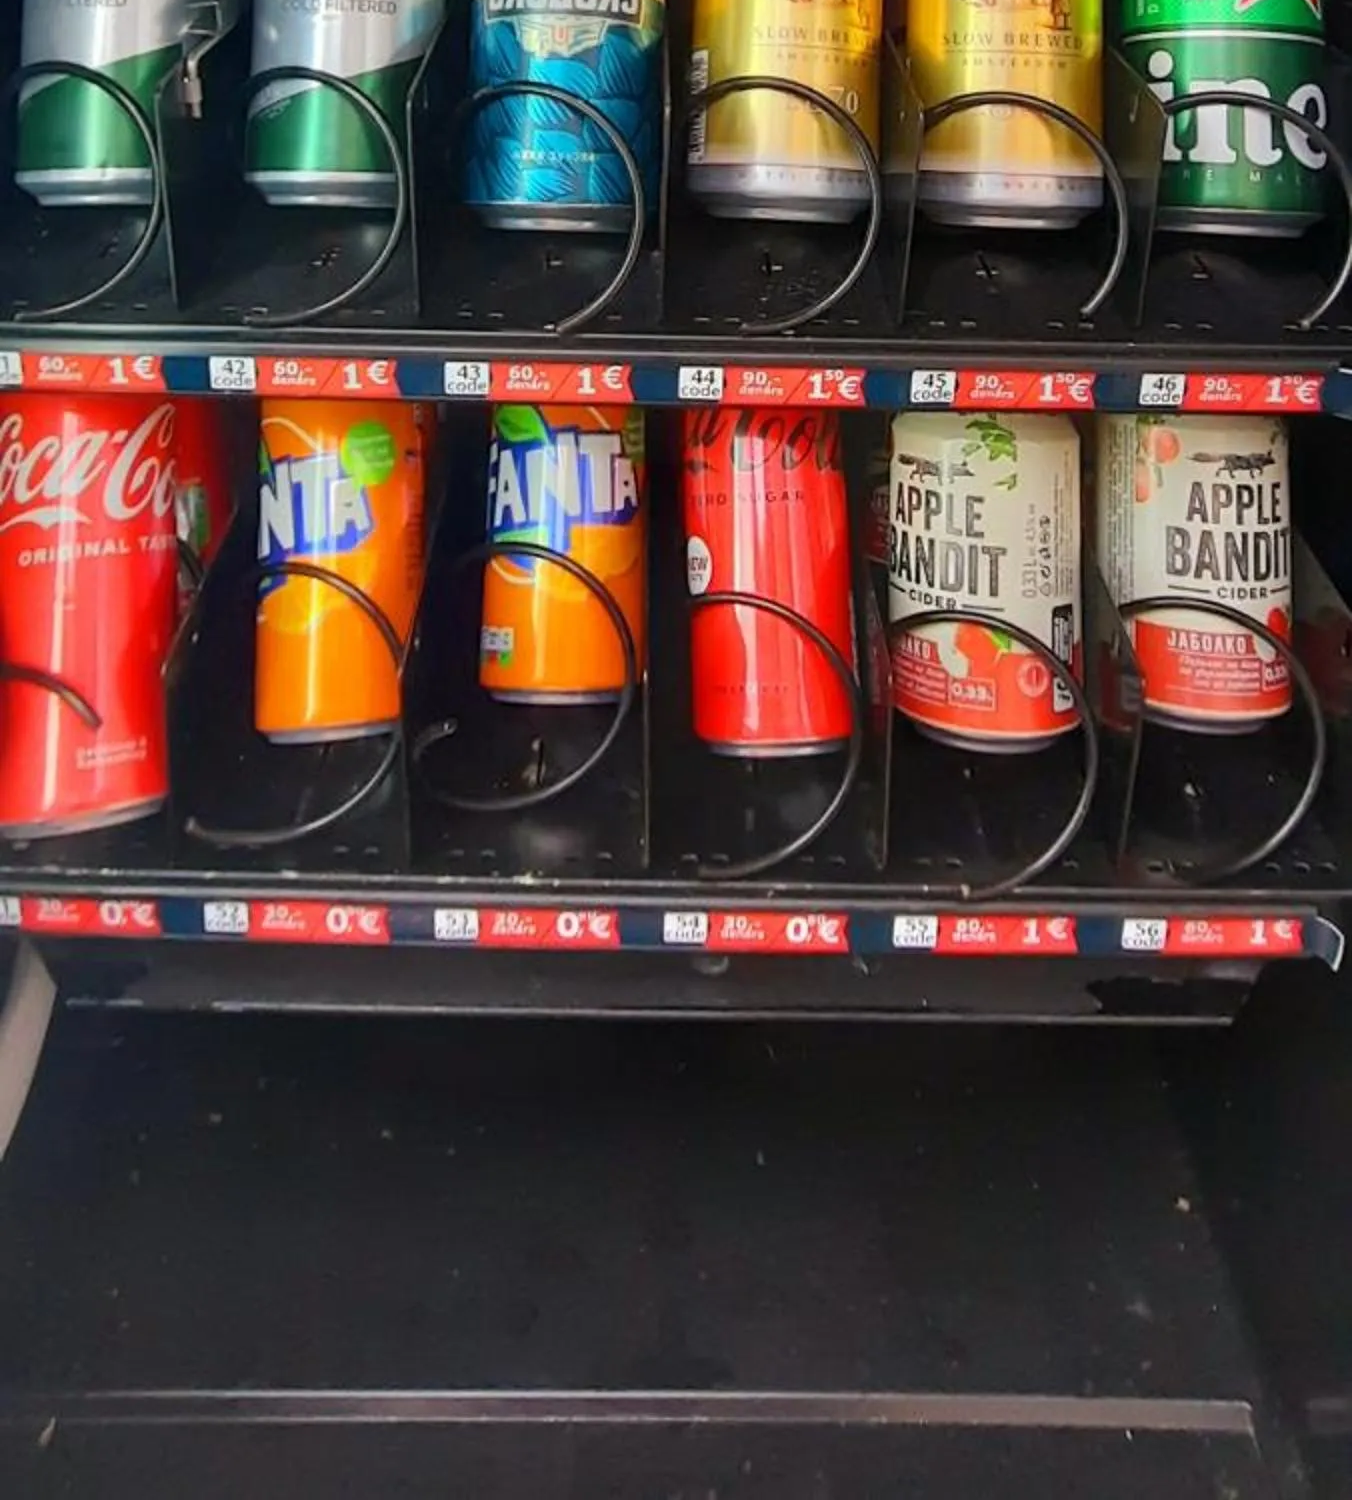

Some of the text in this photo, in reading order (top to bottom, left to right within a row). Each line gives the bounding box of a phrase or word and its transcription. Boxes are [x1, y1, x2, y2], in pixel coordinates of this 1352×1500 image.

[324, 0, 398, 15] FILTERED
[943, 31, 1083, 50] SLOW BREWED
[221, 359, 245, 377] 42
[456, 364, 481, 380] 43
[214, 375, 255, 389] code
[447, 378, 487, 392] code
[690, 369, 715, 385] 44
[922, 373, 947, 389] 45
[1151, 376, 1177, 392] 46
[680, 382, 721, 398] code
[912, 387, 951, 401] code
[1141, 391, 1180, 404] code
[895, 481, 986, 539] APPLE
[1185, 481, 1282, 525] APPLE
[18, 538, 131, 568] ORIGINAL
[889, 523, 1008, 599] BANDIT
[1165, 526, 1290, 583] BANDIT
[908, 589, 958, 611] CIDER
[1216, 585, 1269, 600] CIDER
